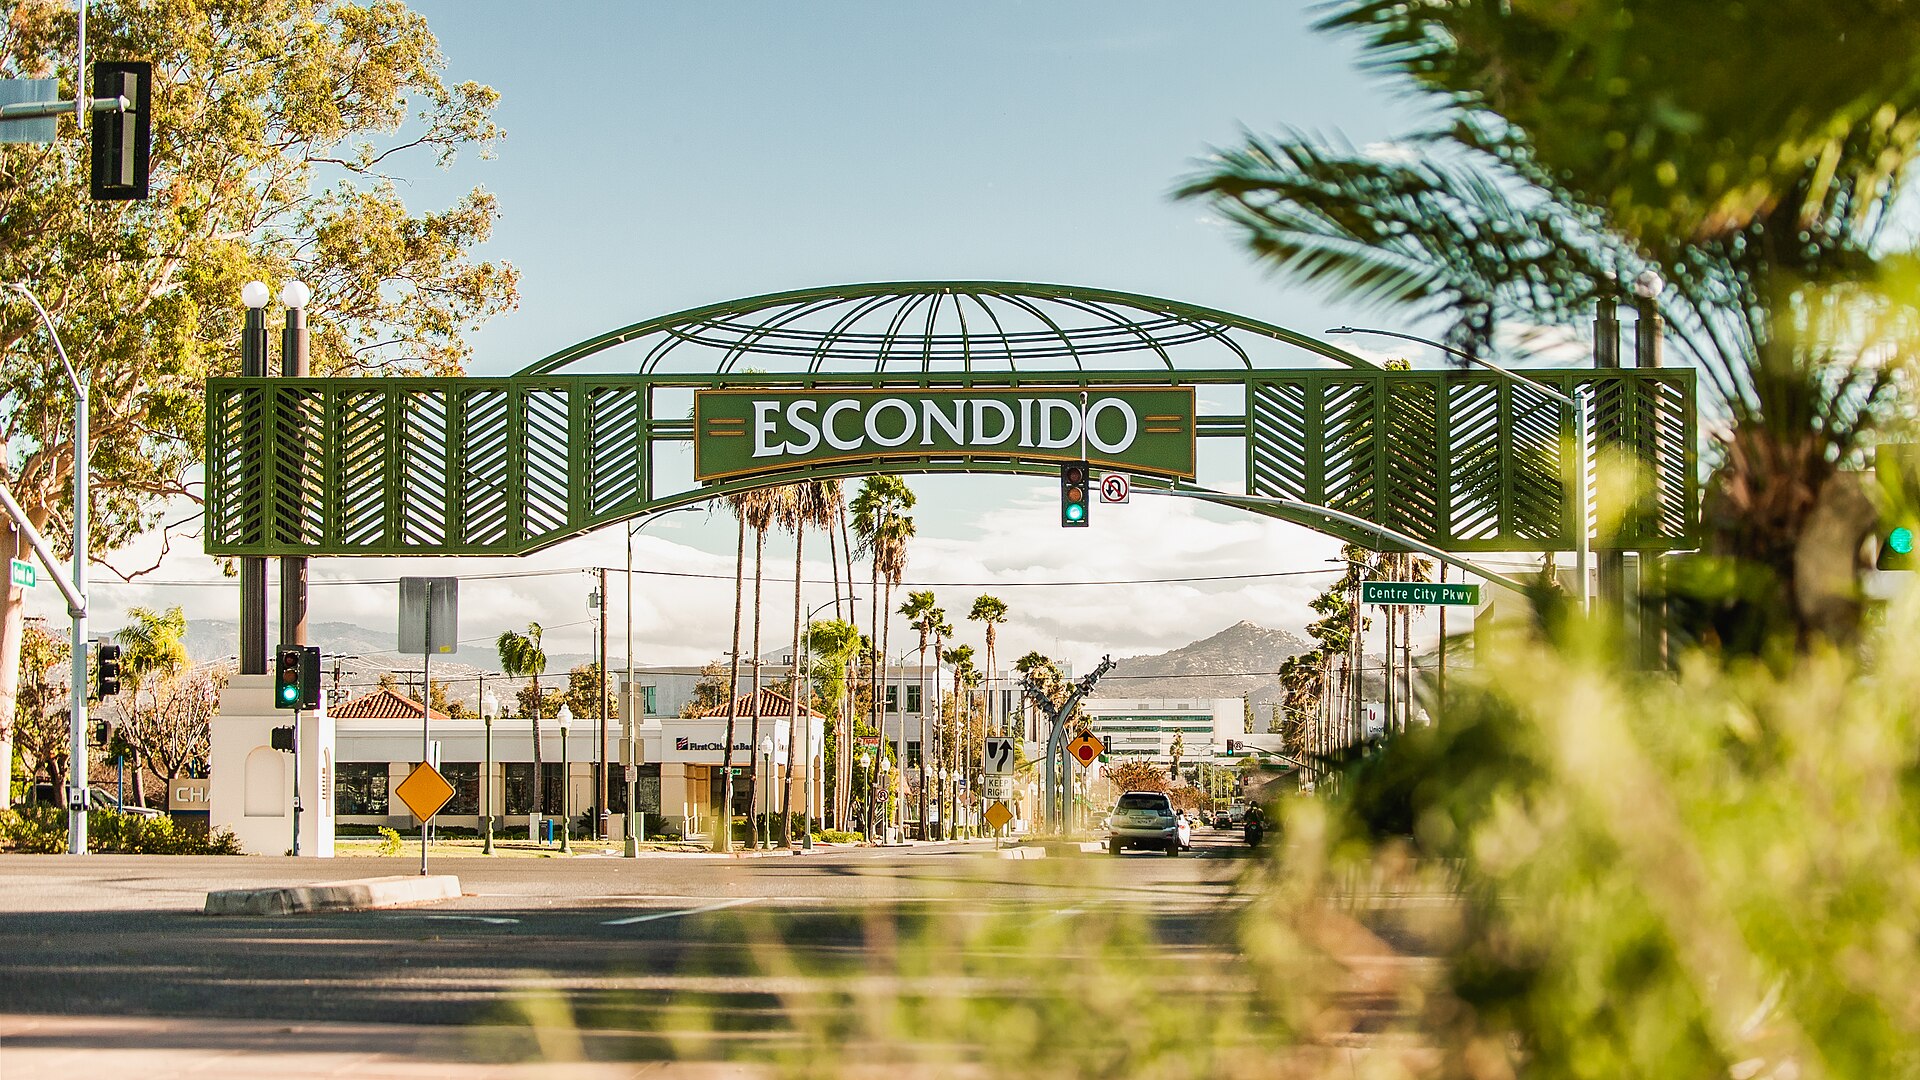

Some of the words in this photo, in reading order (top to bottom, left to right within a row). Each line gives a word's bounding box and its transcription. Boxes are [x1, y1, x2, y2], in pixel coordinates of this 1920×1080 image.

[752, 397, 1138, 458] ESCONDIDO
[1369, 587, 1408, 599] Centre
[1414, 588, 1437, 602] City
[1442, 589, 1472, 603] Pkwy
[989, 779, 1009, 787] KEEP
[987, 788, 1009, 796] RIGHT
